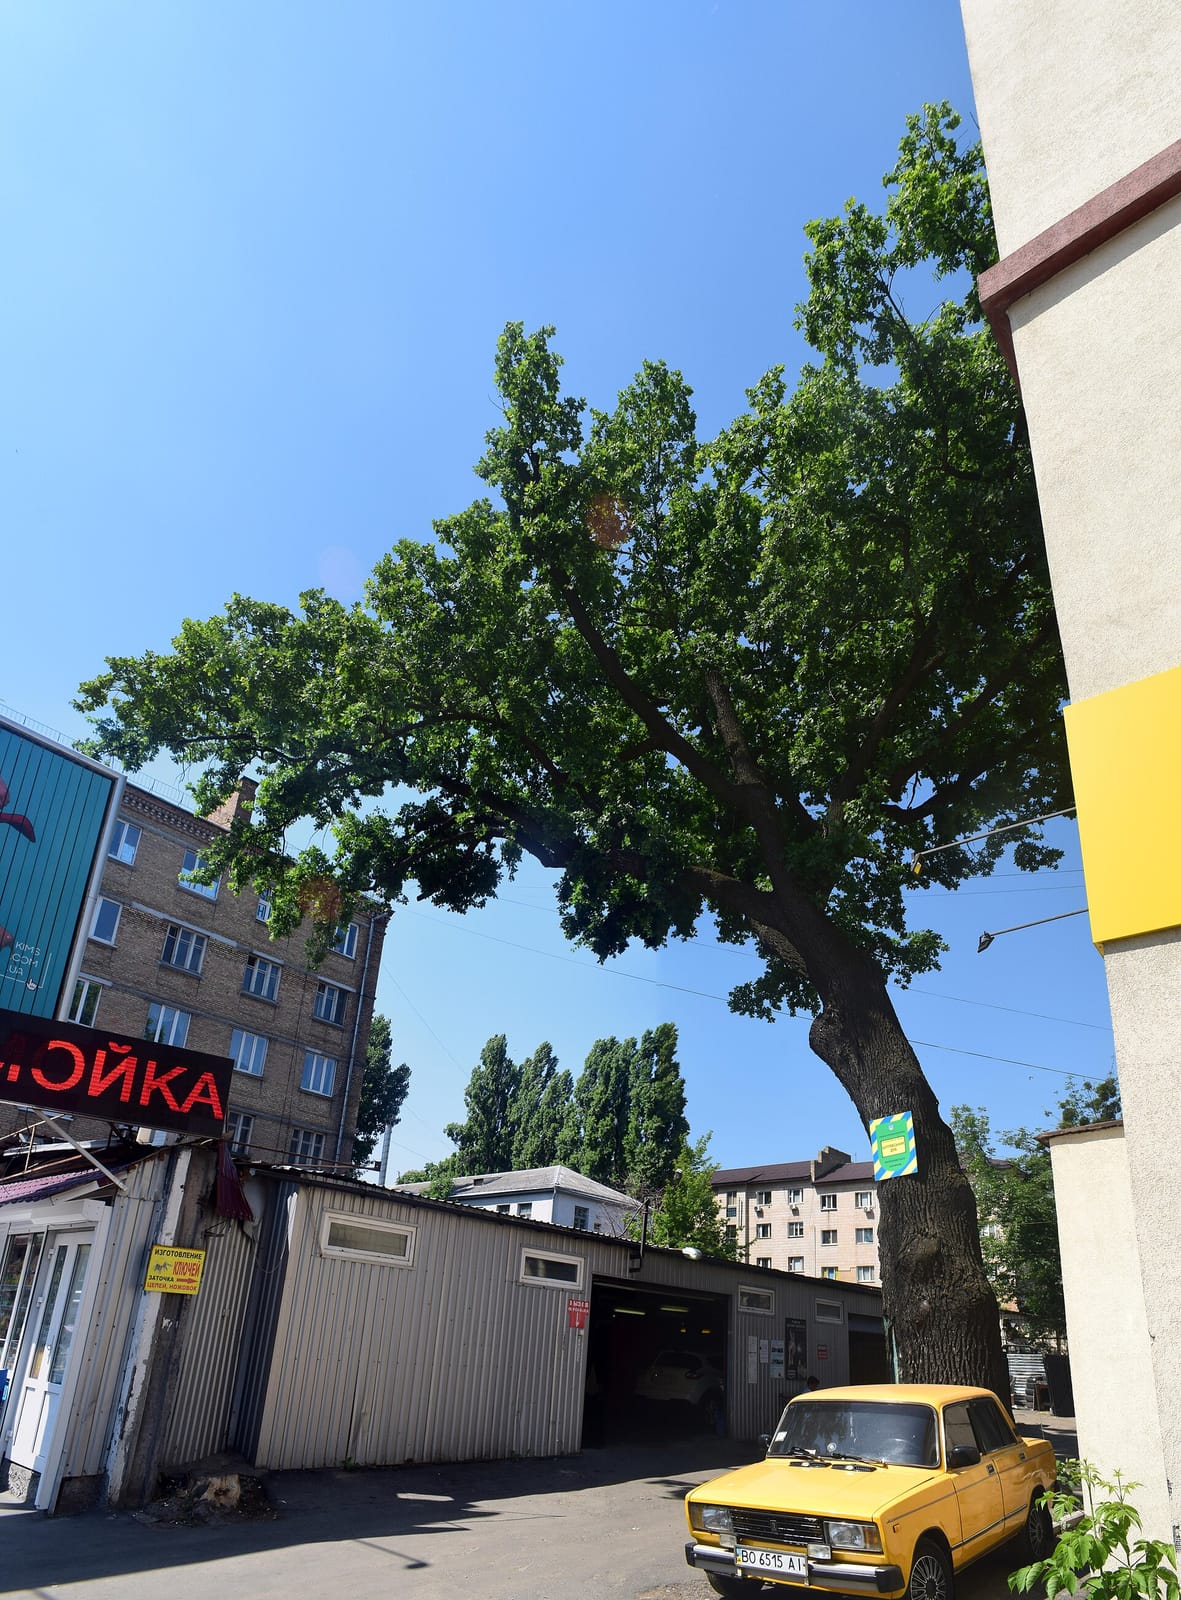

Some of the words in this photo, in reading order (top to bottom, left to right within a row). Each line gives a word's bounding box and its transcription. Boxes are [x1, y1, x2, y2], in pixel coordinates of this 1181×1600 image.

[154, 1249, 203, 1260] ИЗГОТОВЛЕНИЕ
[173, 1260, 200, 1277] КЛЮЧЕЙ
[148, 1275, 174, 1283] ЗАТОЧКА
[759, 1552, 783, 1569] 6515
